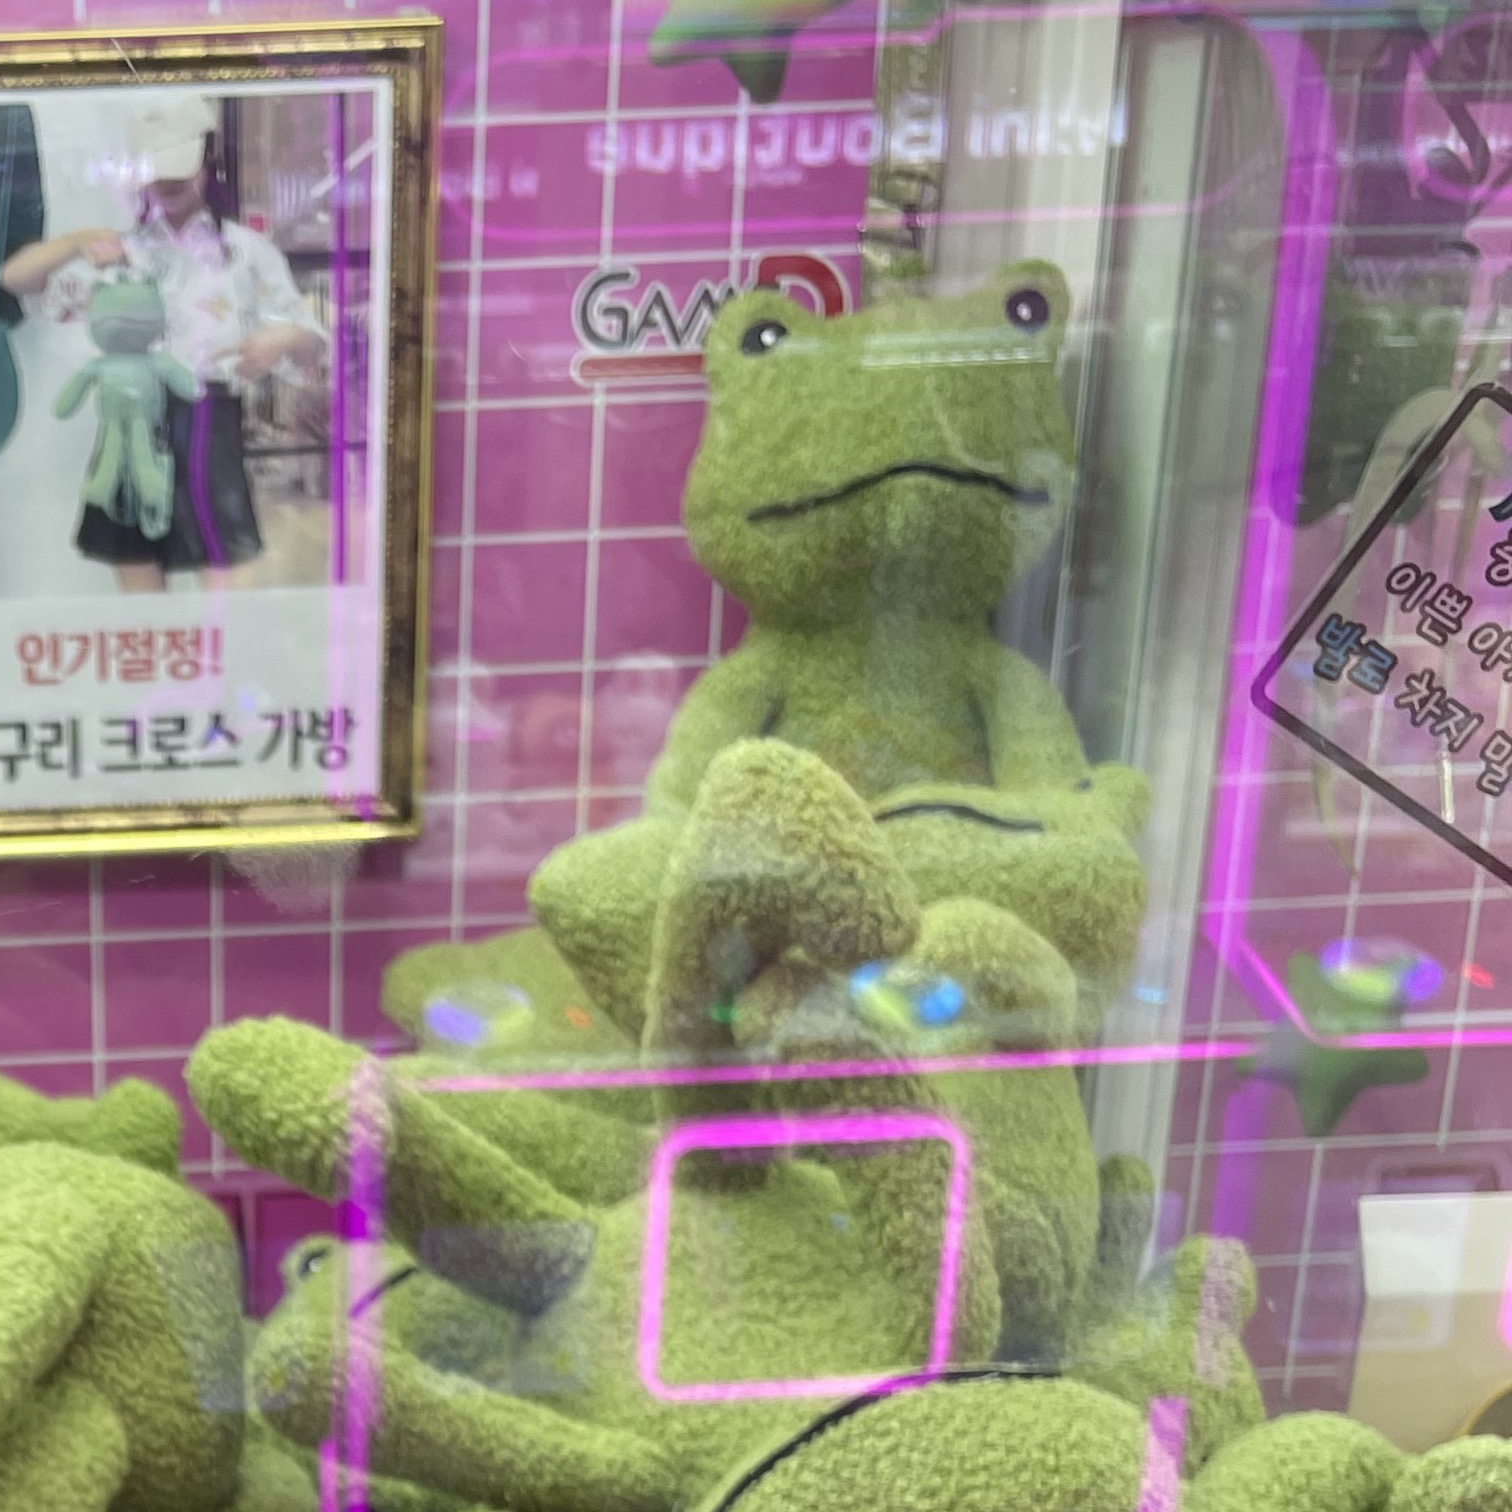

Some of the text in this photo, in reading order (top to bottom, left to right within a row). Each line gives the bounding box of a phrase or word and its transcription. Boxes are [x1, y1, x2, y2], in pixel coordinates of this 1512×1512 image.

[1386, 562, 1473, 646] 이쁜
[16, 626, 225, 686] 인기절정!
[1313, 613, 1398, 695] 발로
[1394, 668, 1484, 752] 차지
[98, 711, 242, 772] 크로스
[256, 705, 355, 772] 가방
